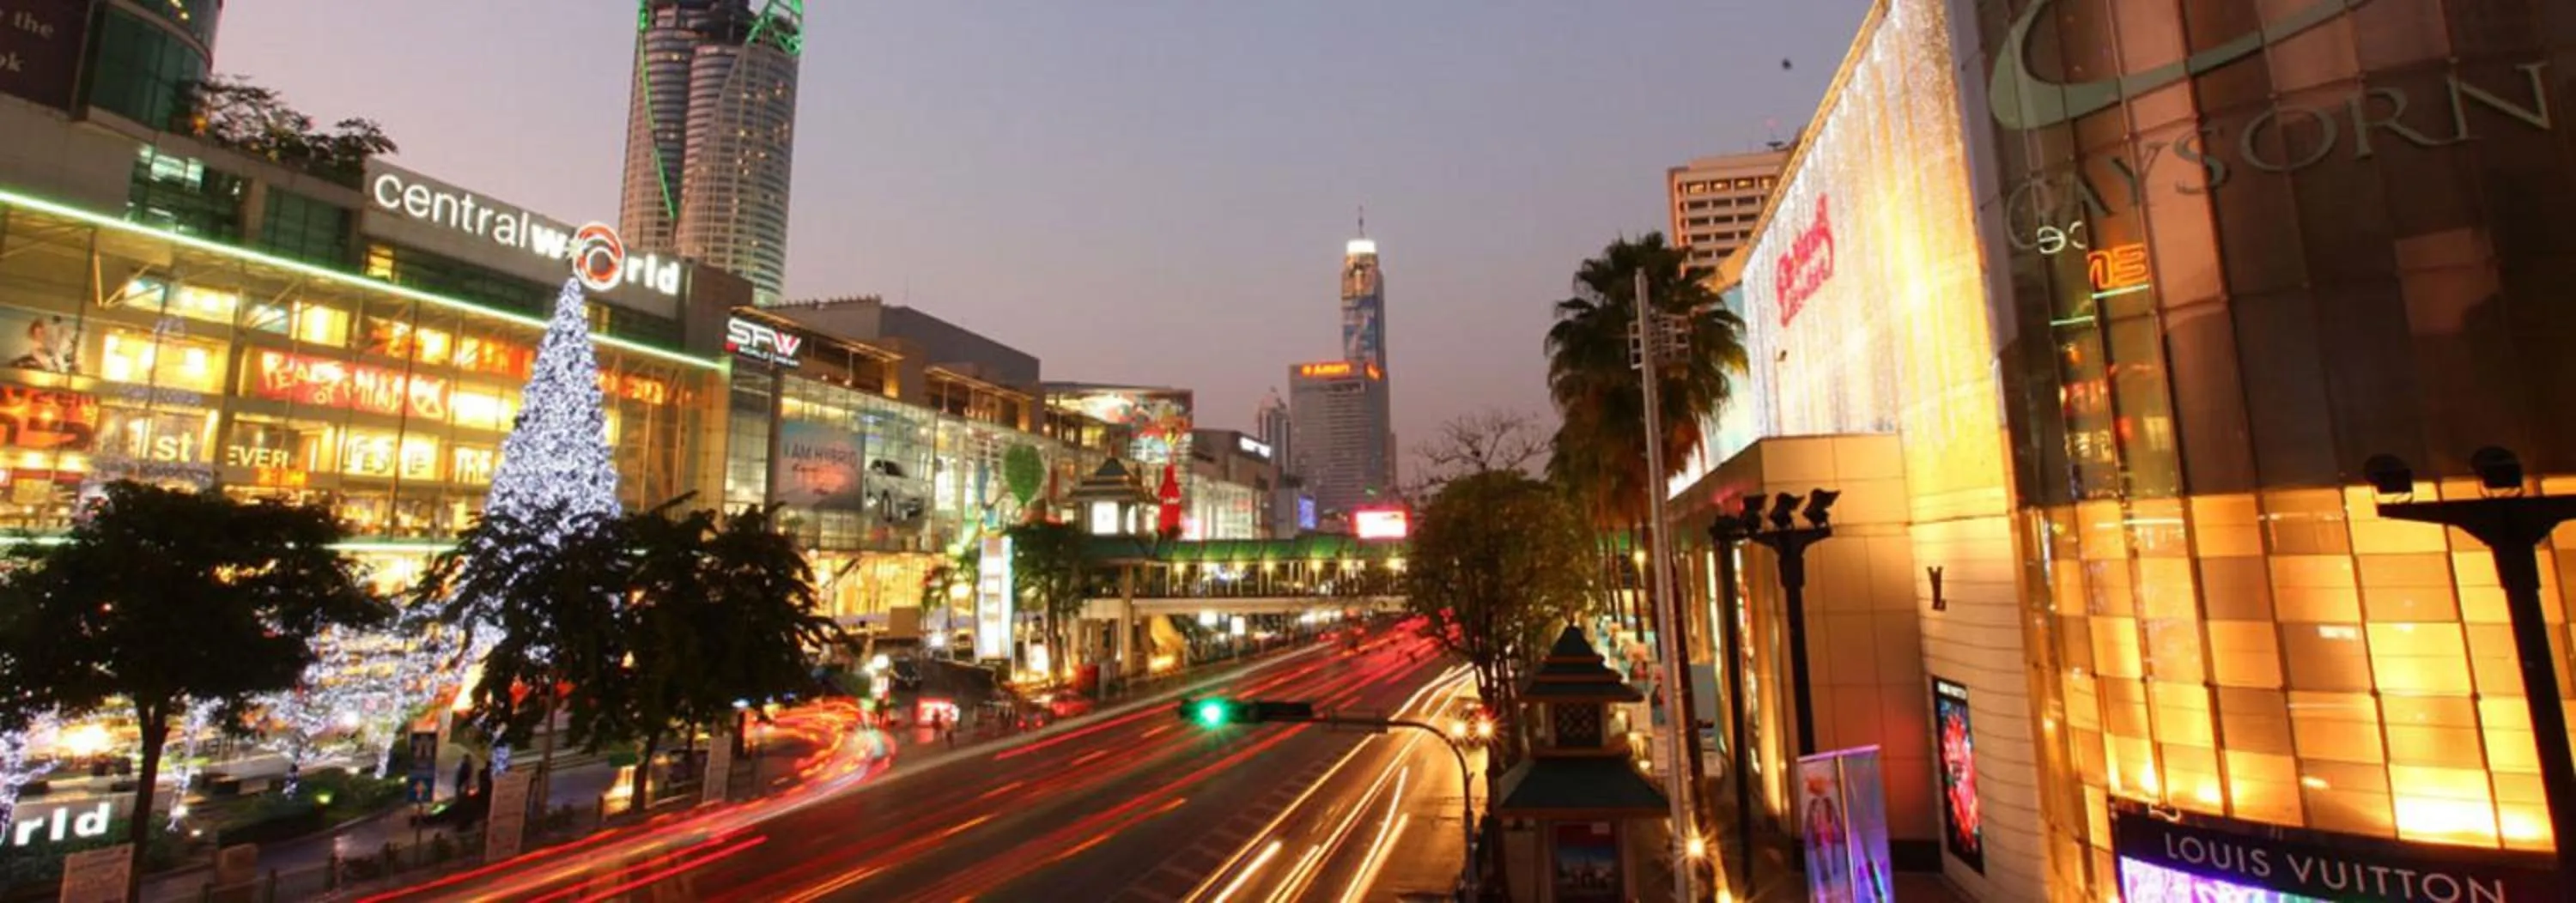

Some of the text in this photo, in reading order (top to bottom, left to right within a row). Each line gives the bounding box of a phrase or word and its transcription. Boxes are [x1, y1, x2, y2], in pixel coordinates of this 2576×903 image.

[15, 10, 54, 40] the
[374, 173, 681, 296] centralworld
[726, 316, 802, 357] SFW
[127, 416, 195, 464] 1st
[792, 442, 811, 459] AM
[0, 802, 111, 846] rld
[2165, 831, 2506, 903] LOUIS VUITTON
